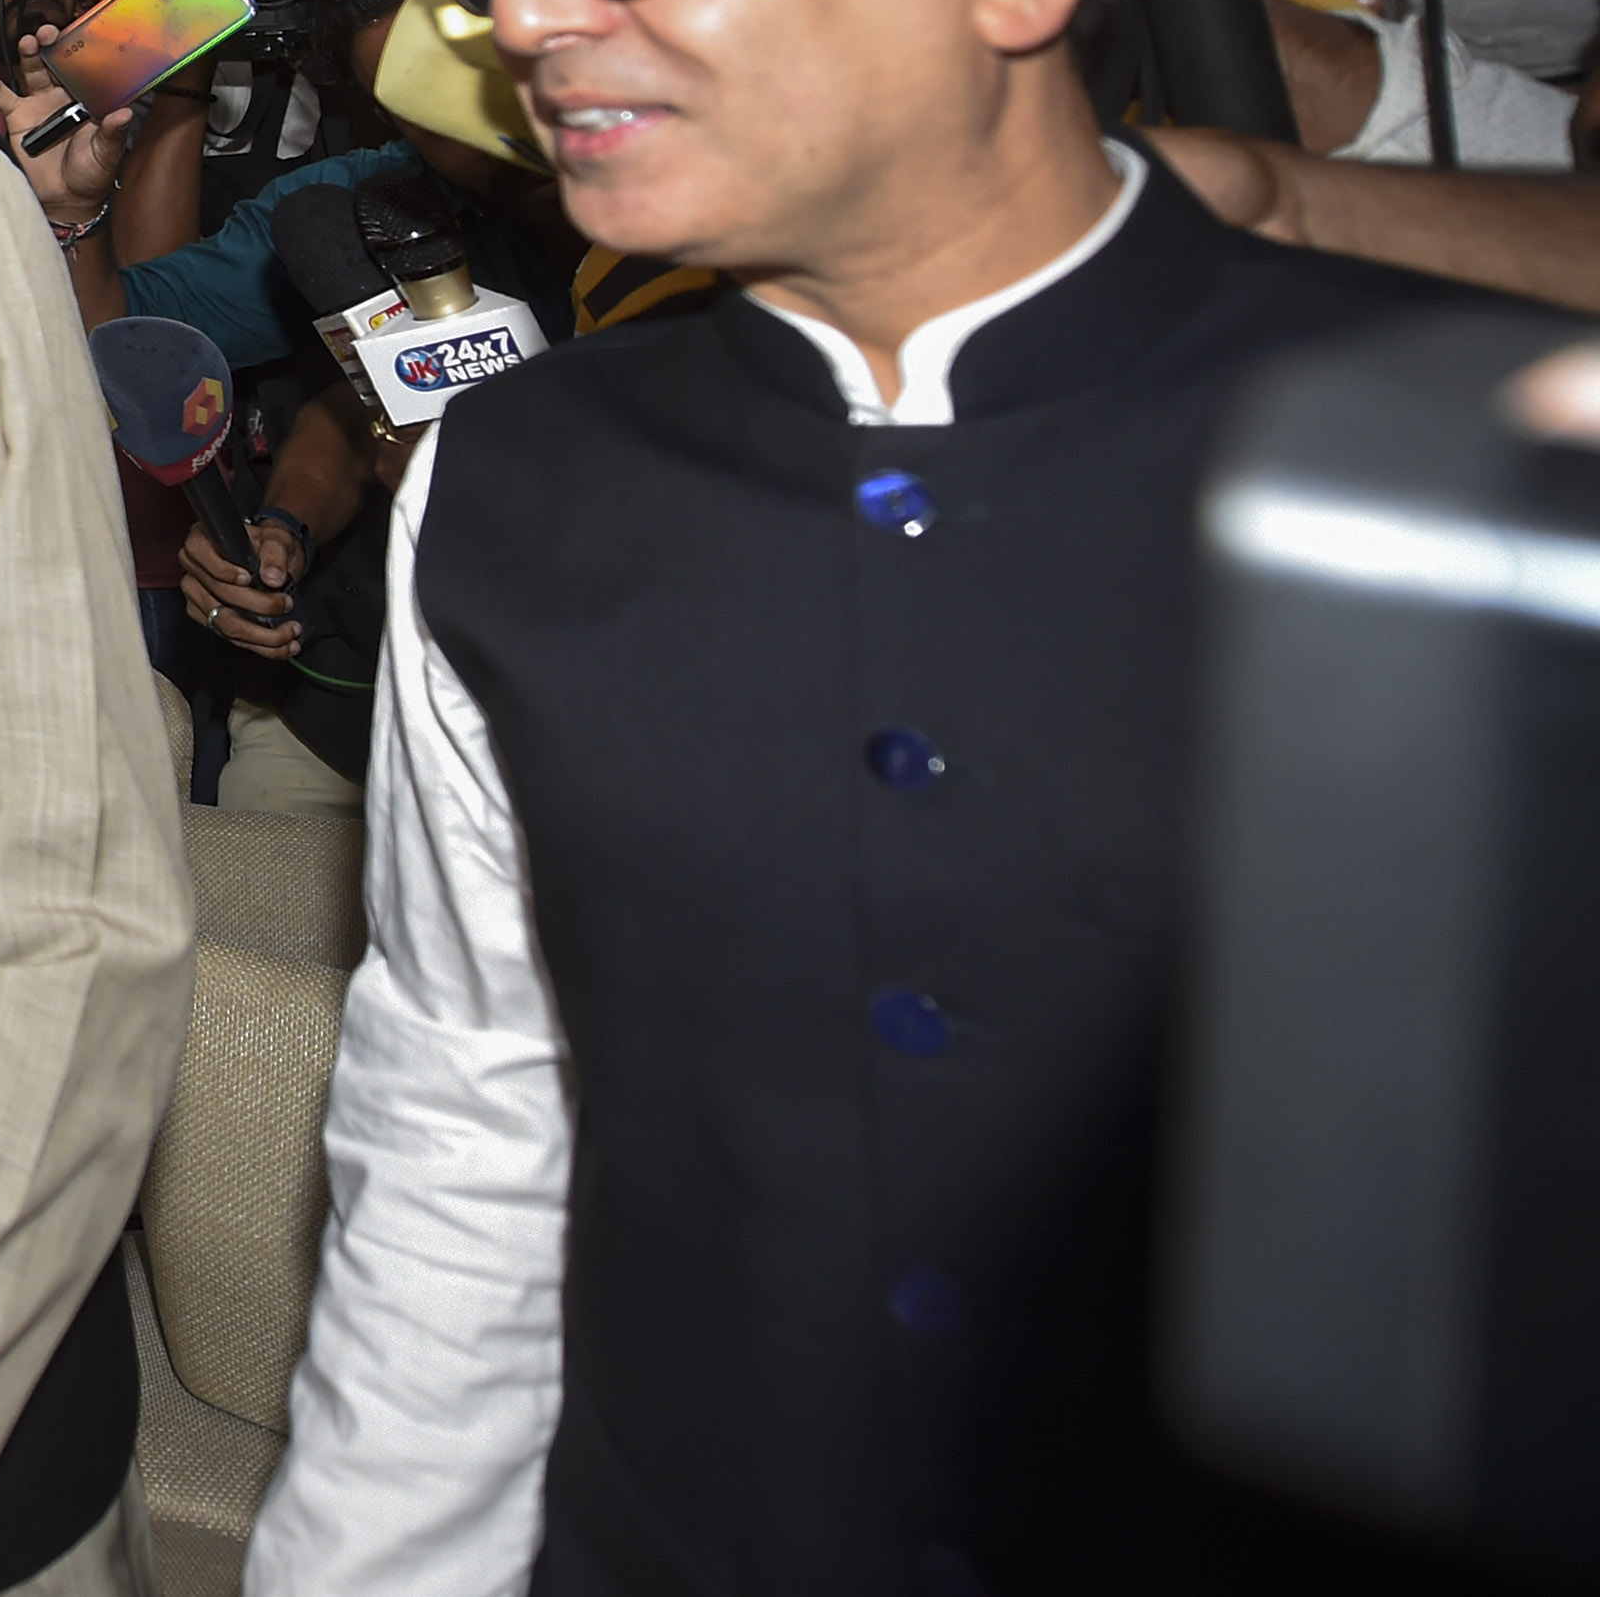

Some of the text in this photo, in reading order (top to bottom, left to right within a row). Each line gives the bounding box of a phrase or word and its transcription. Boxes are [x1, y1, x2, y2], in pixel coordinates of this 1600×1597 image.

[436, 330, 510, 368] 24x7
[404, 357, 441, 384] JK
[446, 353, 522, 384] NEWS
